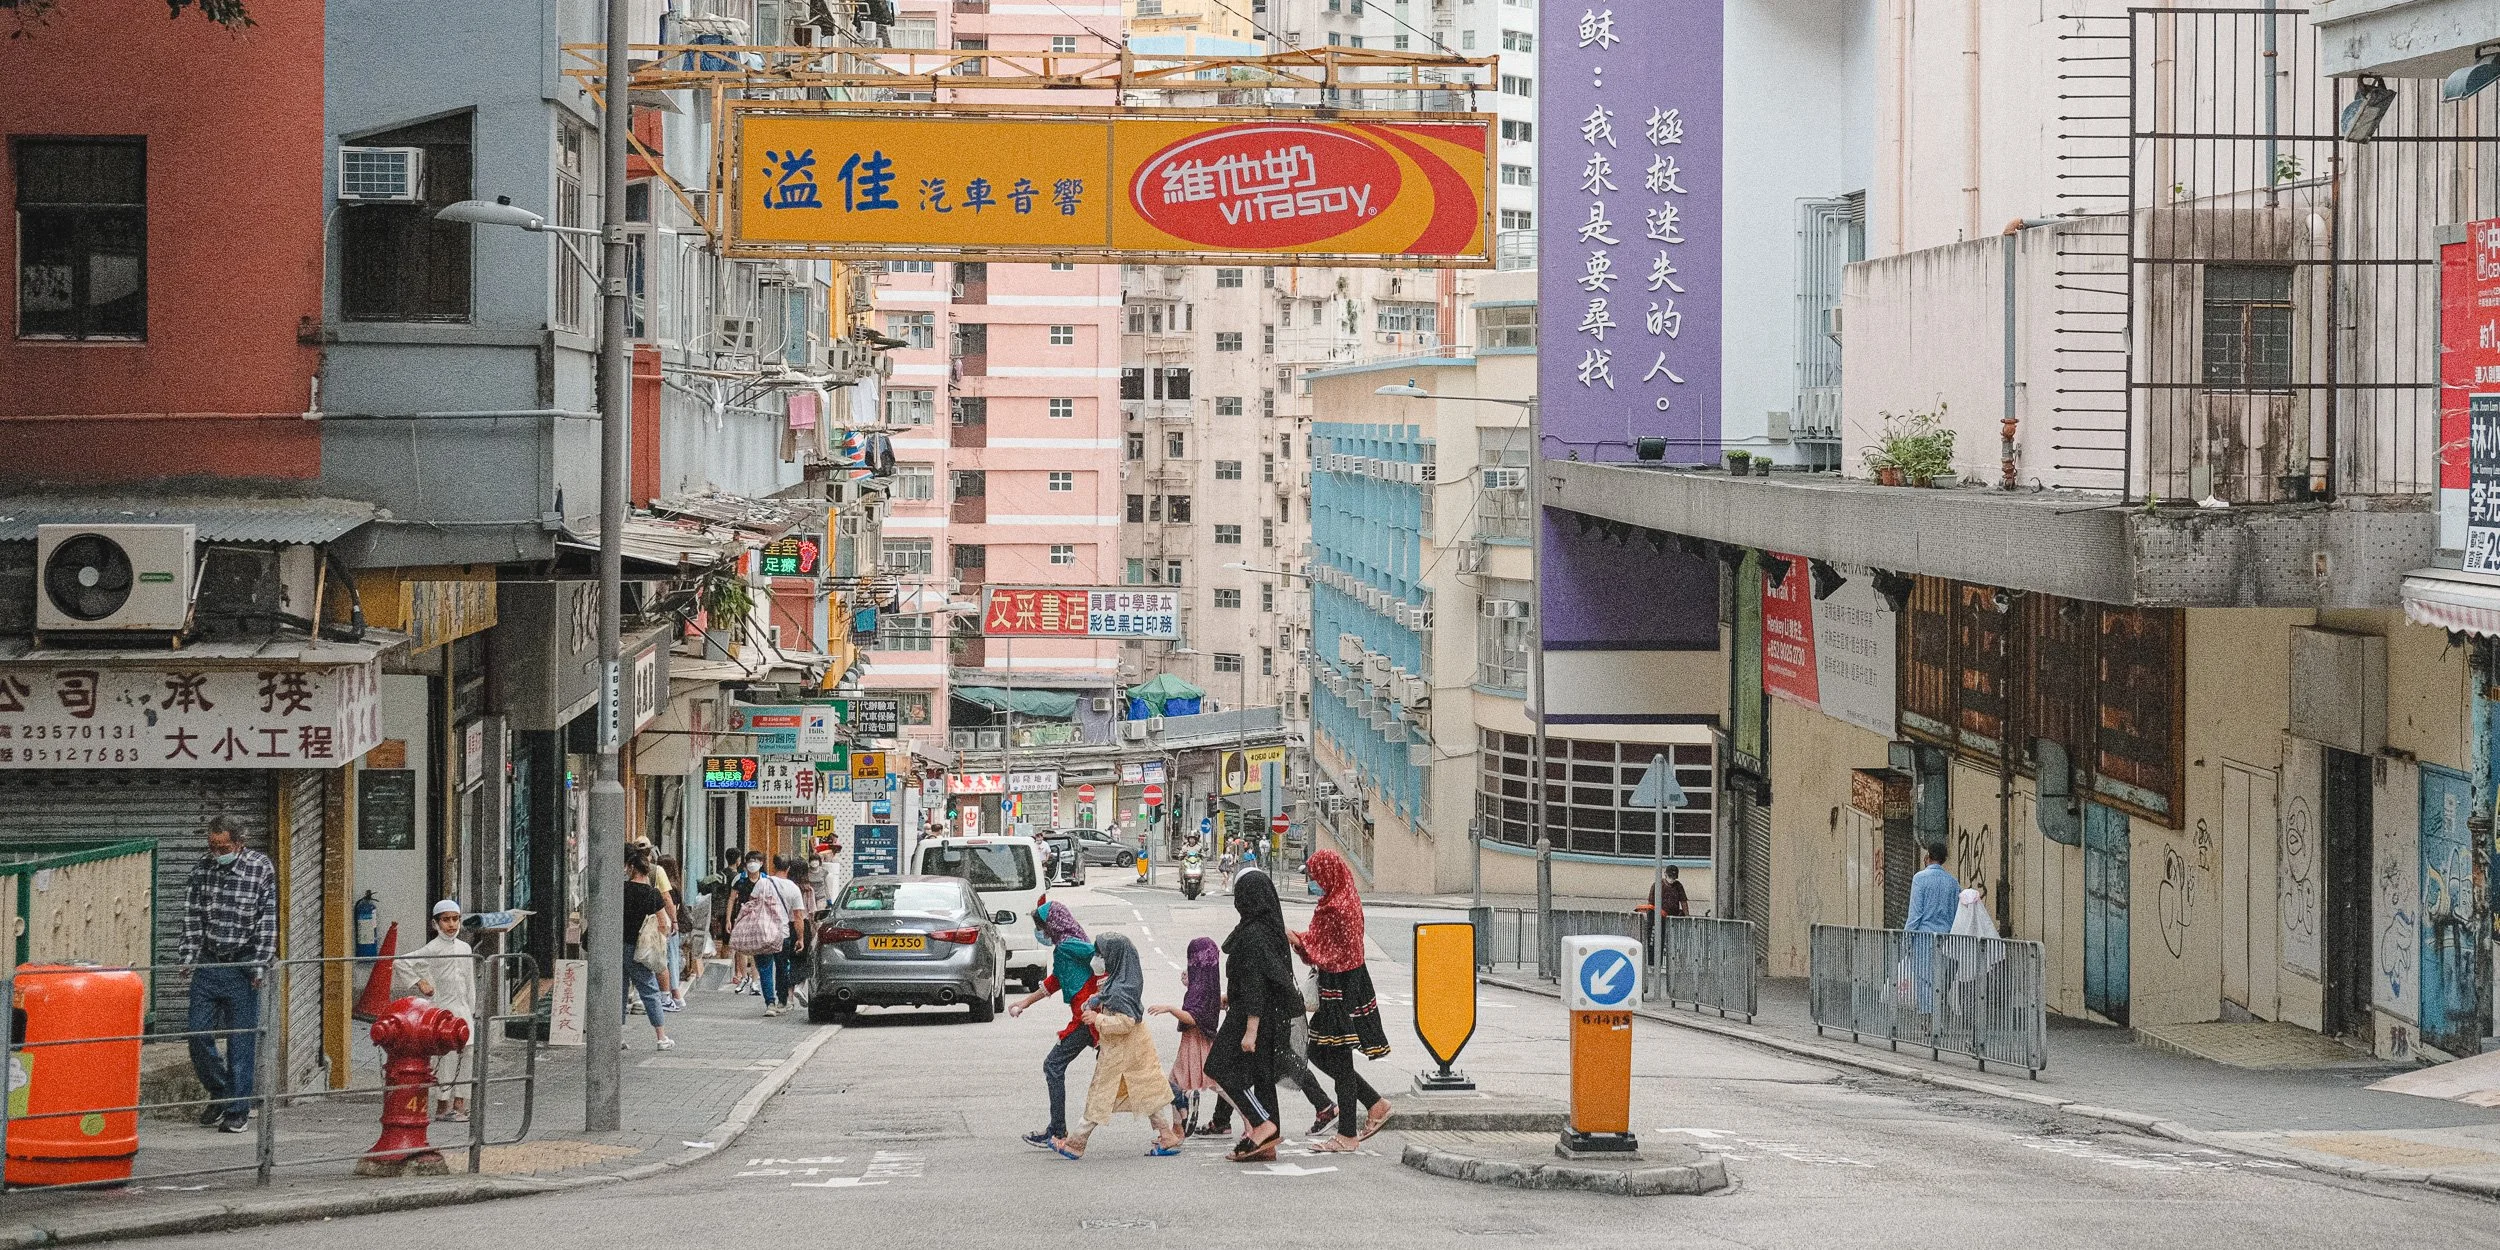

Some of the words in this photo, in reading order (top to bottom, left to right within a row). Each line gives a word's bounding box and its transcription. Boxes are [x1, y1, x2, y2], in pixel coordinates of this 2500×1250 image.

[762, 148, 899, 213] 溢佳
[918, 178, 1084, 216] 汽車音響
[1161, 145, 1317, 204] 維他奶
[1090, 593, 1173, 612] 買賣中學課本
[1090, 614, 1173, 634] 彩色黑白印務
[0, 669, 99, 719] 公司
[161, 672, 314, 717] 承接
[23, 725, 136, 740] 23570131
[164, 726, 334, 761] 大小工程
[23, 747, 140, 762] 95127683
[872, 938, 888, 948] VH
[891, 938, 922, 948] 2350
